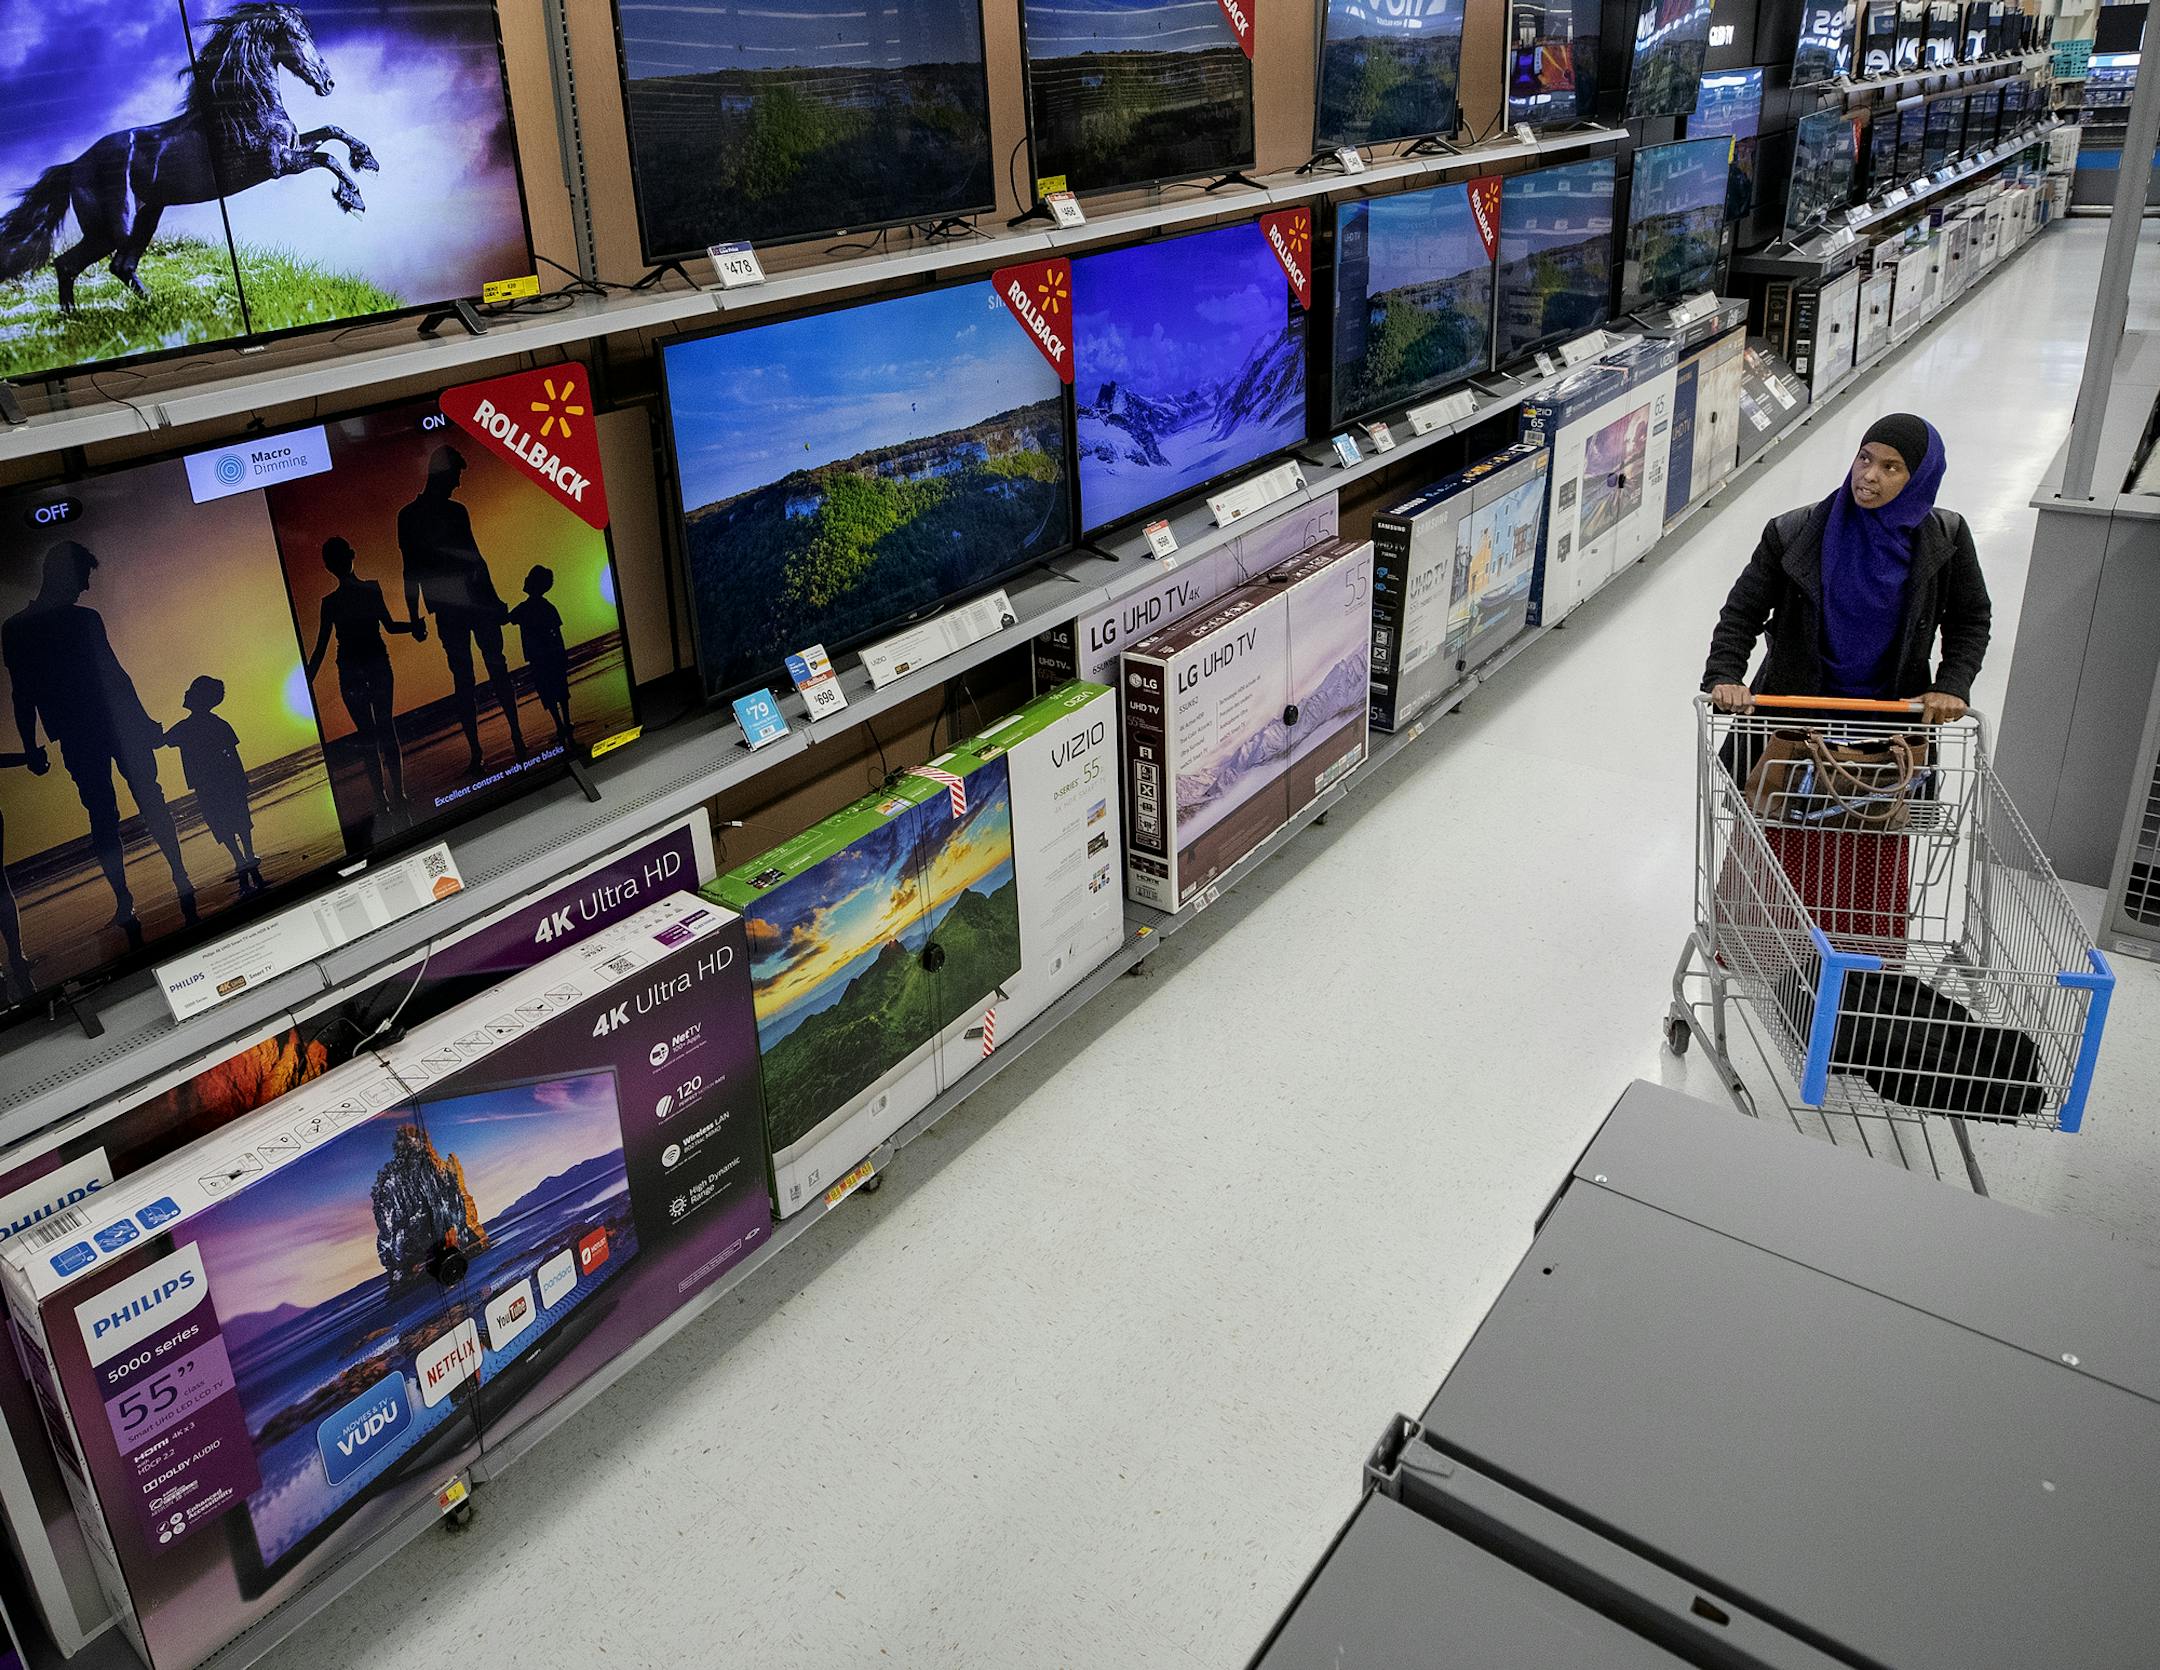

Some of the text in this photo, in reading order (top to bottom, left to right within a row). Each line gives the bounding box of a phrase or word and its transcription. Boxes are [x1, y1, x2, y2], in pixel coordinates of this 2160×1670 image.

[1472, 188, 1494, 246] ROLLBACK
[725, 259, 752, 275] $478
[1269, 224, 1306, 292] ROLLBACK
[988, 294, 1007, 310] SA
[1008, 280, 1066, 362] ROLLBACK
[422, 413, 446, 430] ON
[251, 447, 291, 464] Macro
[253, 455, 308, 476] Dimming
[473, 399, 591, 503] ROLLBACK
[35, 503, 69, 523] OFF
[1378, 522, 1406, 533] SAMSUNG
[1410, 569, 1433, 599] UHD
[1090, 618, 1116, 652] LG
[1123, 597, 1161, 635] UHD
[1165, 580, 1189, 613] TV
[1053, 631, 1069, 644] LG
[1038, 656, 1056, 667] UHD
[1178, 627, 1257, 695] LG UHD TV
[814, 689, 835, 706] $698
[1143, 677, 1158, 689] LG
[745, 702, 769, 721] $79
[1130, 701, 1160, 715] UHD TV
[1051, 721, 1105, 768] VIZIO
[434, 745, 565, 808] Excellent contrast with pure blacks
[535, 851, 681, 944] 4K Ultra HD
[169, 972, 205, 993] PHILIPS
[249, 964, 272, 980] Smart TV
[218, 981, 231, 994] 4K
[592, 945, 734, 1039] 4K Ultra HD
[676, 1075, 702, 1100] 120
[682, 1123, 715, 1146] Wireless
[714, 1111, 730, 1127] LAN
[689, 1179, 707, 1196] High
[707, 1156, 741, 1183] Dynamic
[691, 1184, 715, 1204] Range
[543, 1265, 573, 1294] pandora
[93, 1270, 195, 1339] PHILIPS
[497, 1296, 527, 1329] YouTube
[108, 1324, 200, 1384] 5000 series
[426, 1338, 476, 1388] NETFLIX
[184, 1380, 206, 1397] class
[127, 1380, 224, 1443] Smart UHD LED LCD TV
[342, 1397, 388, 1435] MOVIES & TV
[172, 1428, 184, 1440] 4K
[189, 1422, 196, 1430] 3
[336, 1401, 398, 1456] VUDU
[137, 1448, 176, 1476] HDCP 2.2
[158, 1439, 221, 1484] DOLBY AUDIO
[186, 1488, 223, 1515] Enhanced
[187, 1487, 233, 1519] Accessibility
